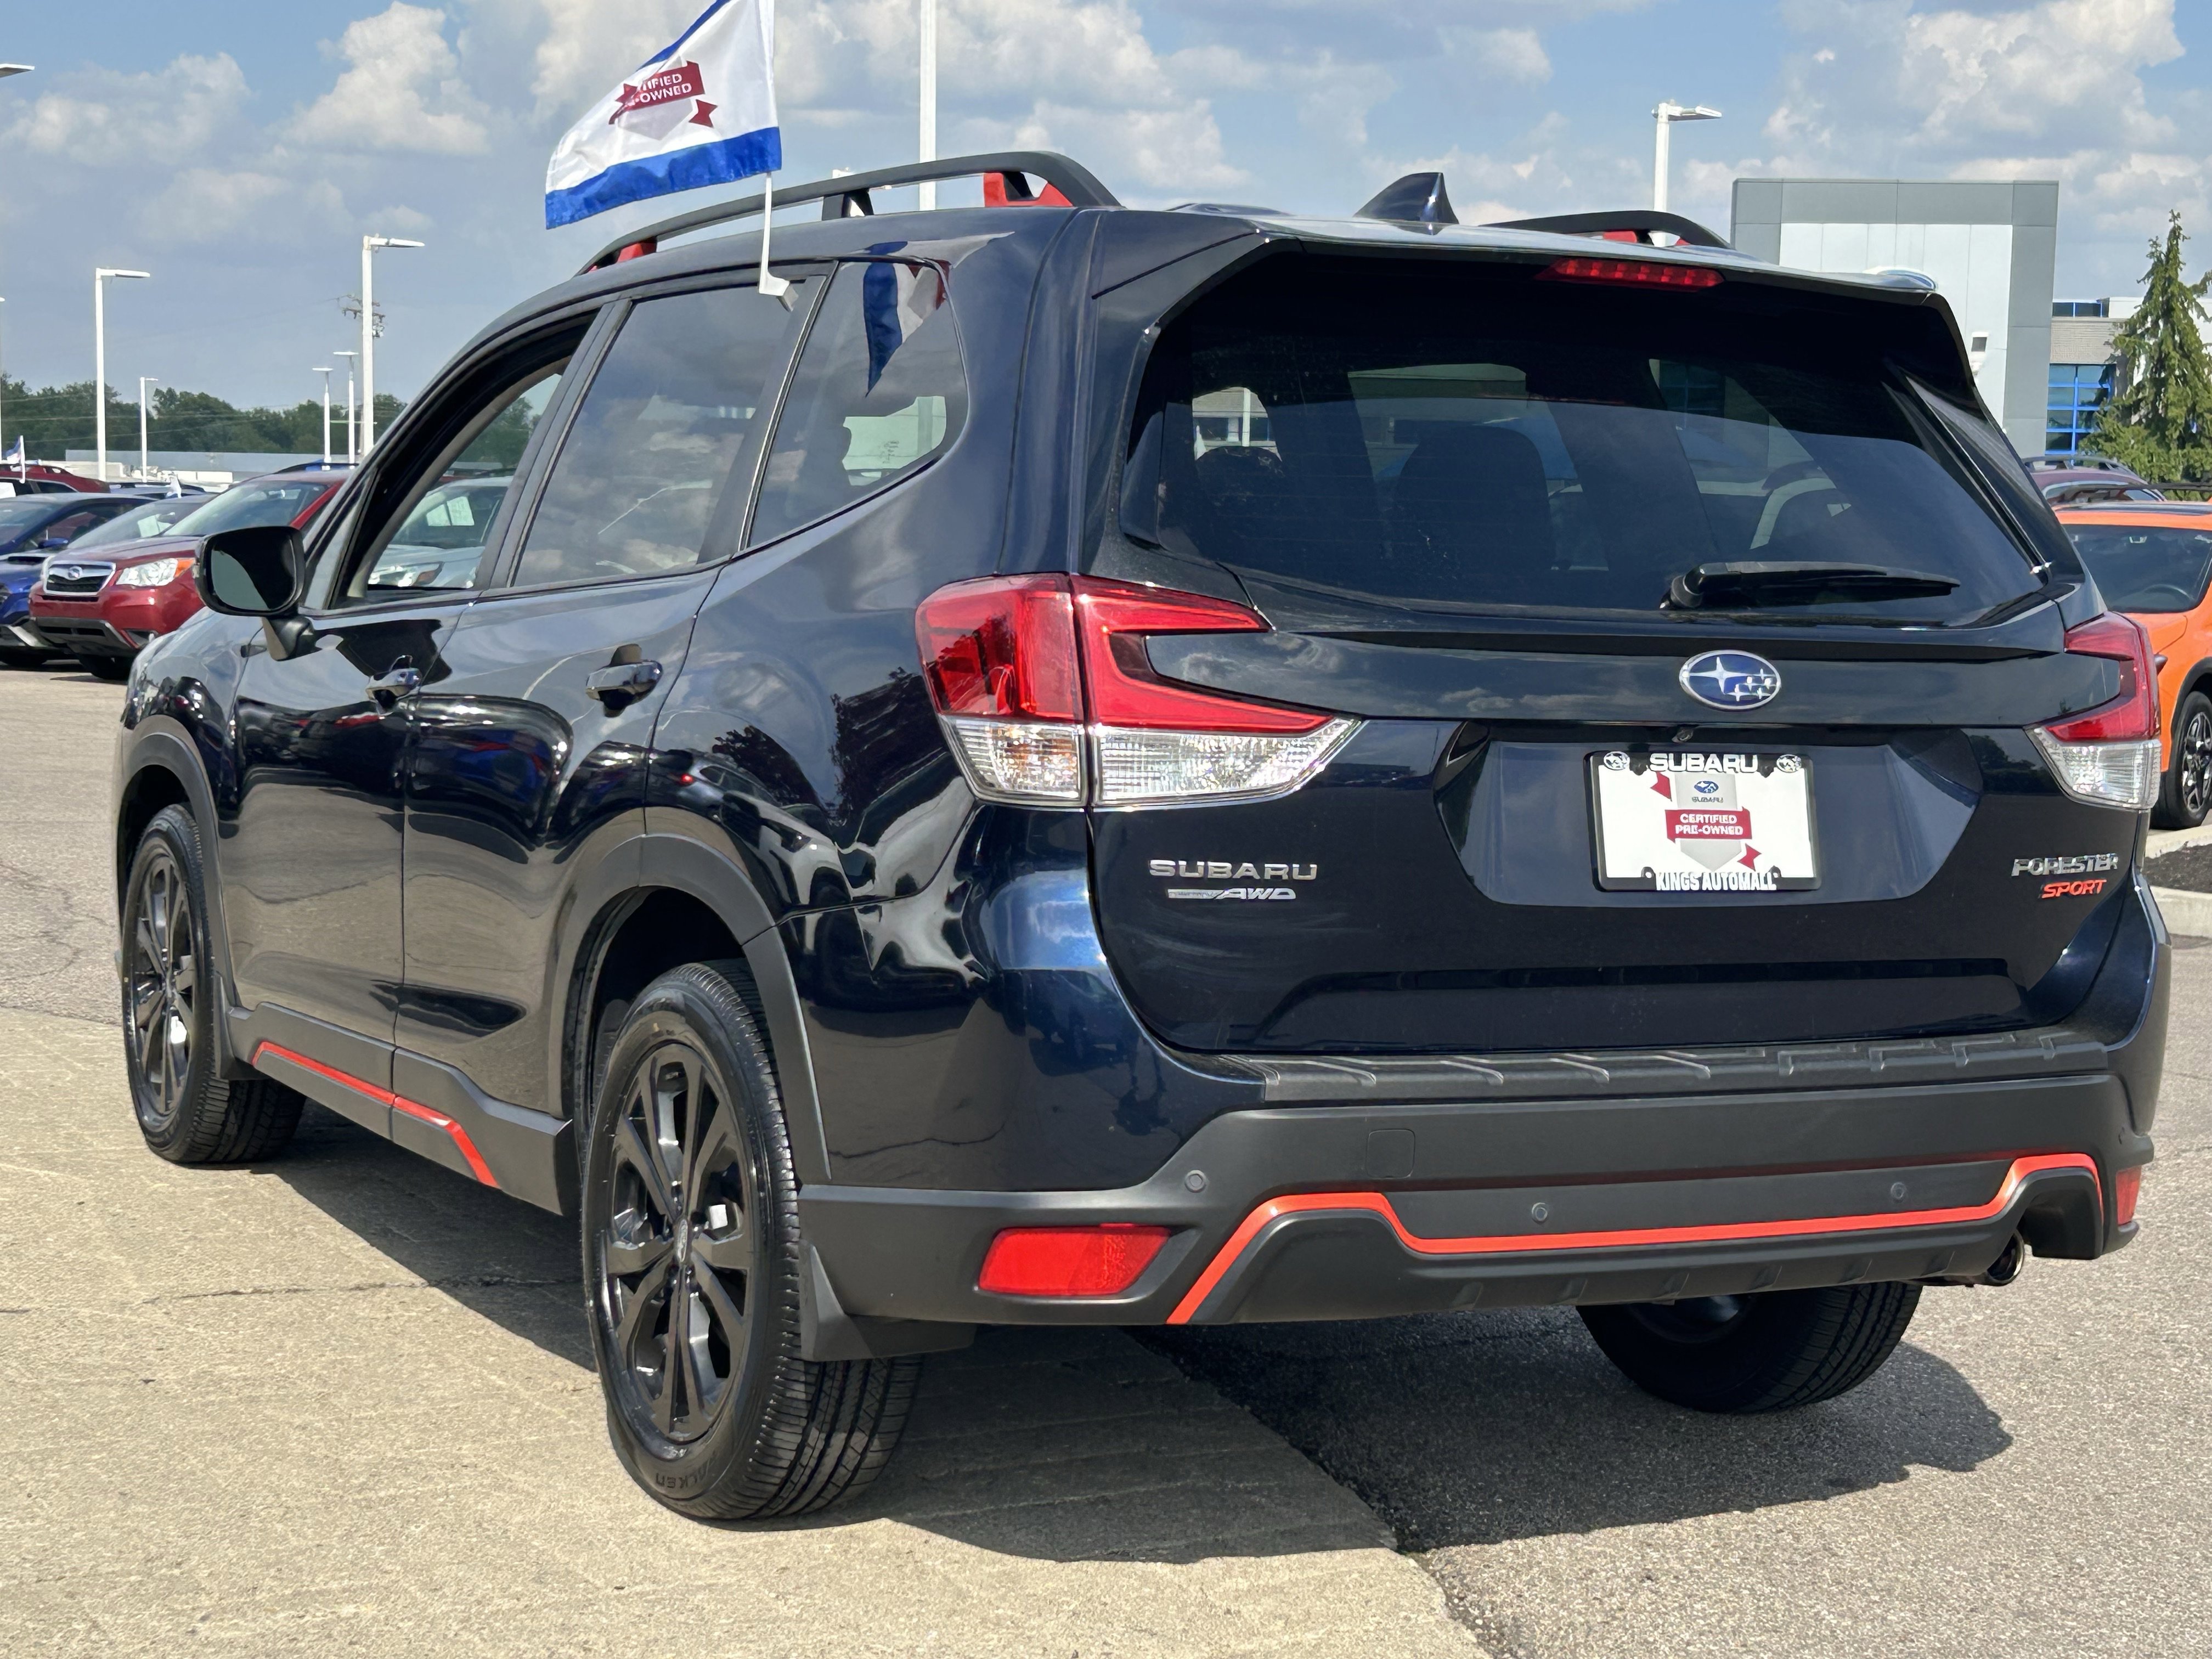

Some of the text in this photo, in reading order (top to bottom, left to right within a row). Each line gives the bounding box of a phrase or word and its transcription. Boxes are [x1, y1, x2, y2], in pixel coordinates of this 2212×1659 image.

[1650, 753, 1758, 772] SUBARU
[1680, 814, 1737, 824] CERTIFIED
[1675, 825, 1743, 836] PRE-OWNED
[1149, 860, 1317, 880] SUBARU
[2011, 853, 2119, 877] FORESTER
[1655, 872, 1777, 891] KINGS AUTOMALL
[2041, 879, 2107, 899] SPORT
[1214, 888, 1296, 900] AWD
